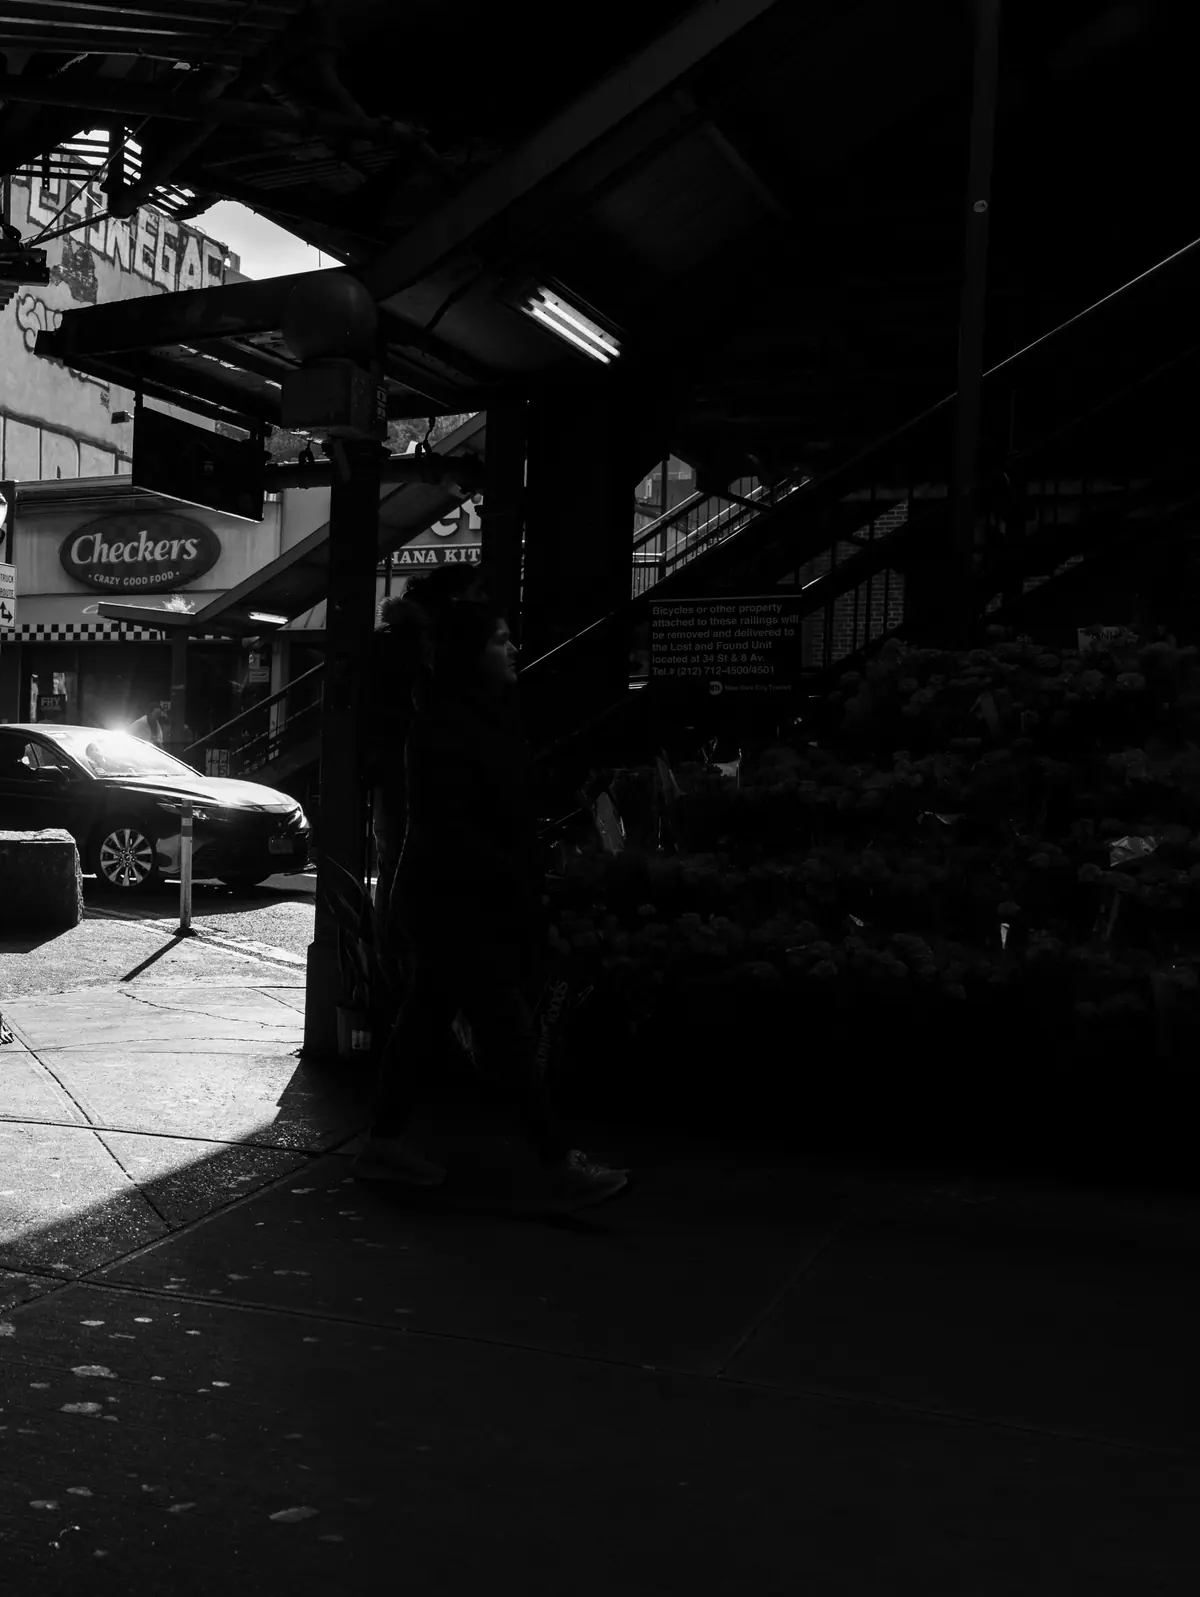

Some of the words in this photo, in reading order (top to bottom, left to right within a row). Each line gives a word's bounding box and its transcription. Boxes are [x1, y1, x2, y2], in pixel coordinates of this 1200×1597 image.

[71, 530, 198, 565] Checkers
[392, 550, 438, 564] IANA
[444, 548, 481, 563] KIT
[0, 573, 14, 583] TRUCK
[94, 573, 120, 585] CRAZY
[124, 576, 148, 586] GOOD
[150, 571, 174, 584] FOOD
[0, 588, 14, 598] ROUTE
[652, 605, 694, 616] Bicycles
[710, 605, 736, 614] other
[739, 603, 783, 614] property
[652, 618, 694, 628] attached
[697, 618, 707, 626] to
[710, 617, 737, 626] these
[740, 615, 778, 626] railings
[781, 614, 799, 624] will
[652, 631, 664, 640] be
[667, 630, 710, 639] removed
[713, 628, 732, 638] and
[734, 627, 781, 637] delivered
[784, 627, 795, 636] to
[652, 643, 667, 652] the
[670, 642, 692, 651] Lost
[695, 641, 713, 650] and
[716, 641, 749, 650] Found
[751, 640, 772, 649] Unit
[652, 654, 688, 664] located
[690, 655, 700, 663] at
[702, 654, 714, 663] 34
[717, 653, 728, 663] St
[730, 653, 739, 662] &
[750, 653, 765, 662] Av.
[677, 667, 701, 677] (212)
